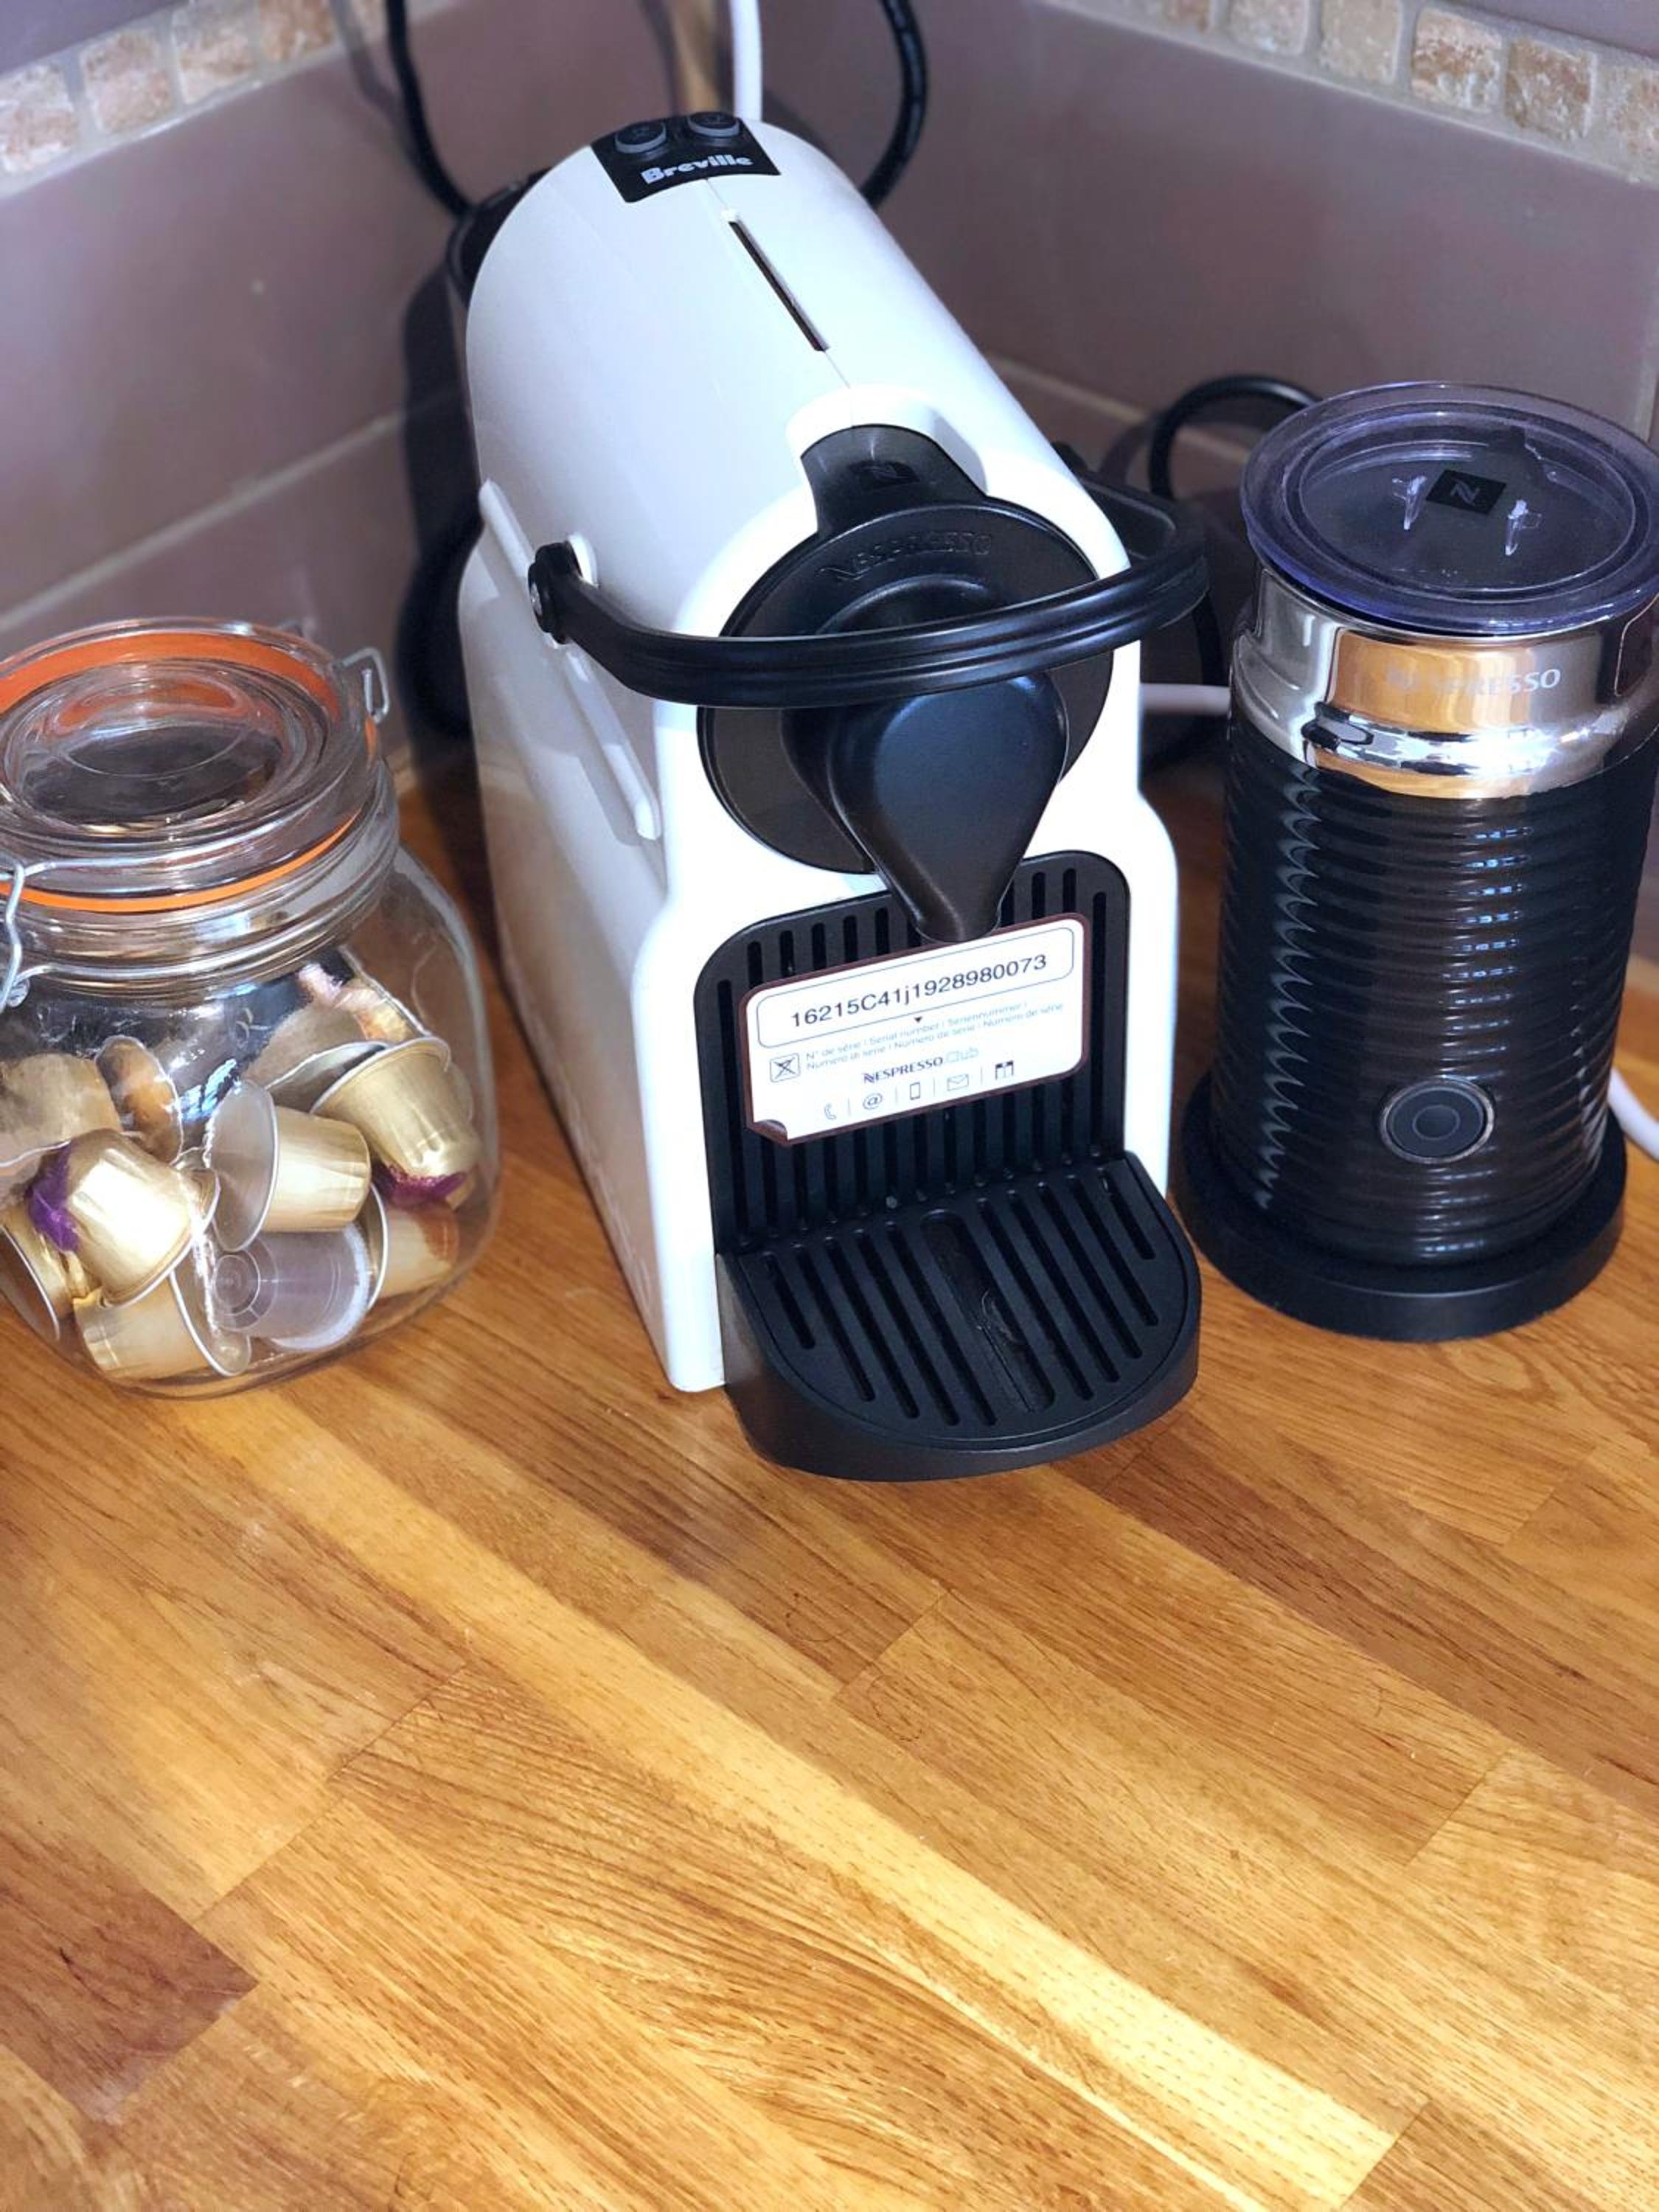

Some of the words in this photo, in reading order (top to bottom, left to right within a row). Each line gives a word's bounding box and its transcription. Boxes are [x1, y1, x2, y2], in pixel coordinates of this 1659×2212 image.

[641, 153, 754, 184] Breville
[1387, 667, 1561, 695] NPRESSO
[869, 1032, 897, 1045] Serial
[900, 1022, 939, 1038] number
[863, 1056, 944, 1084] NESPRESSO
[945, 1046, 978, 1063] Club
